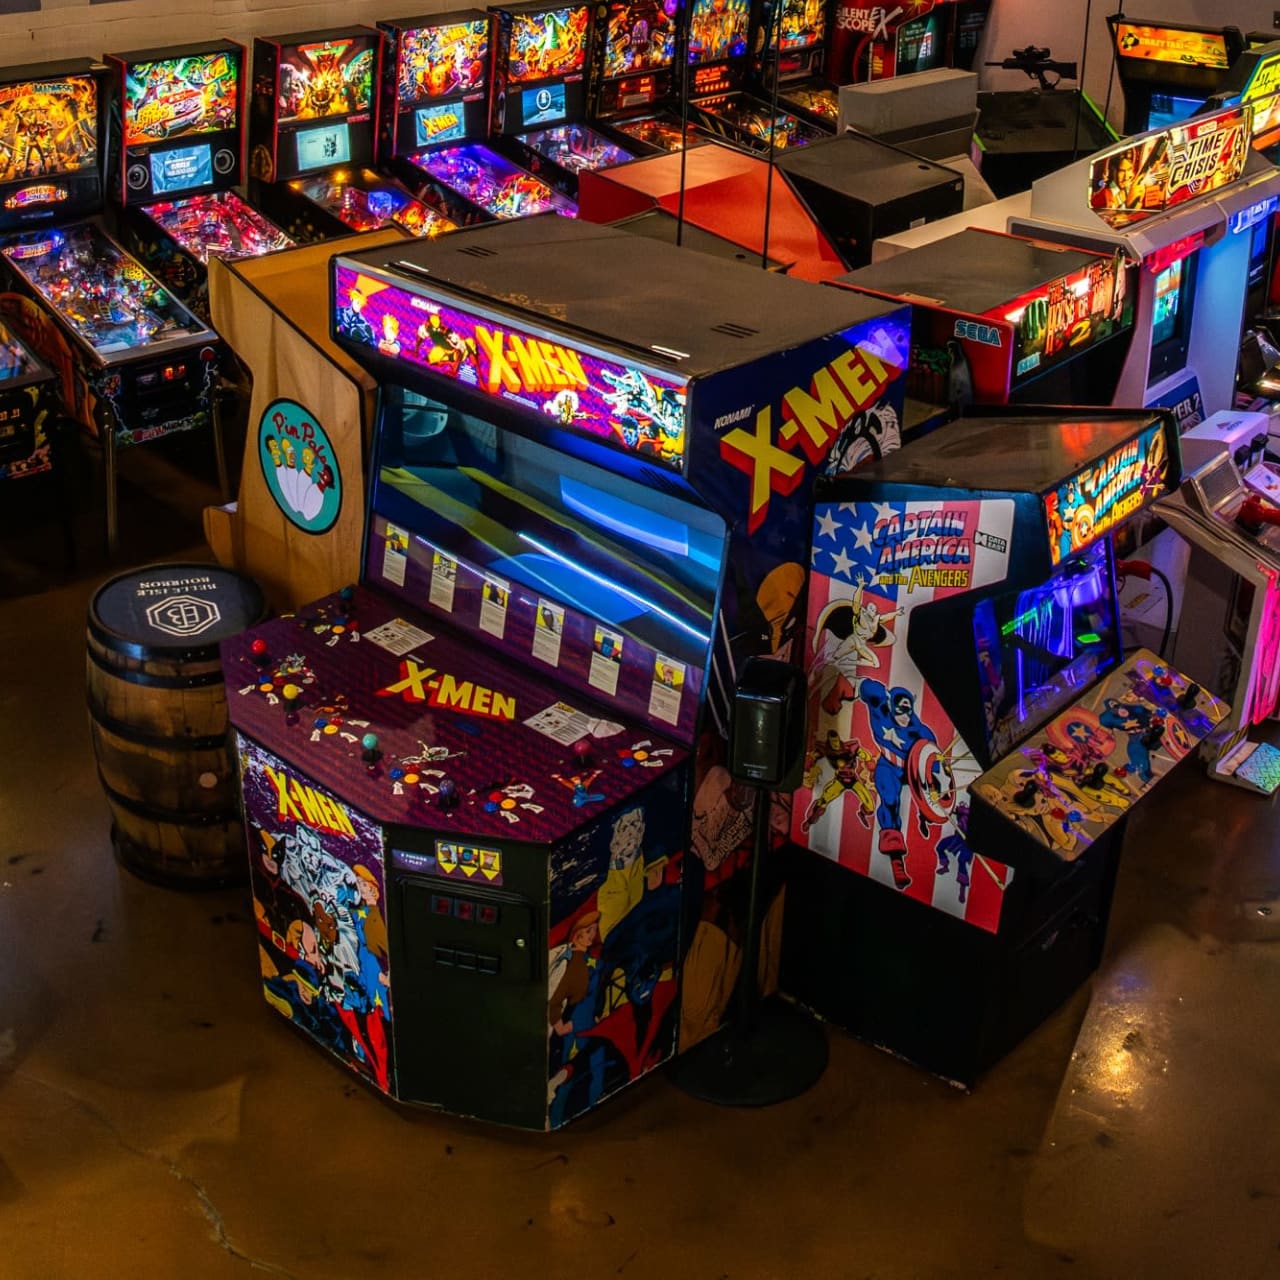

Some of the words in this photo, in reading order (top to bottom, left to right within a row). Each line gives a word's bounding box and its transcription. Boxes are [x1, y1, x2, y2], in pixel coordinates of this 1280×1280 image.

[836, 6, 869, 20] SILENT
[837, 17, 876, 32] SCOPE
[422, 114, 458, 139] X-MEN
[1186, 131, 1225, 158] TIME
[1219, 124, 1238, 165] 4
[1170, 152, 1219, 187] CRISIS
[954, 320, 1002, 347] SEGA
[1069, 318, 1091, 347] 2
[475, 324, 590, 395] X-MEN
[272, 411, 300, 439] Pin
[714, 404, 754, 430] KONAMI
[720, 327, 905, 535] X-MEN
[1091, 439, 1139, 497] CAPTAIN
[1094, 461, 1141, 523] AMERICA
[872, 510, 968, 547] CAPTAIN
[877, 538, 971, 575] AMERICA
[139, 576, 210, 589] BOURBON
[377, 658, 516, 720] X-MEN
[263, 764, 357, 838] X-MEN
